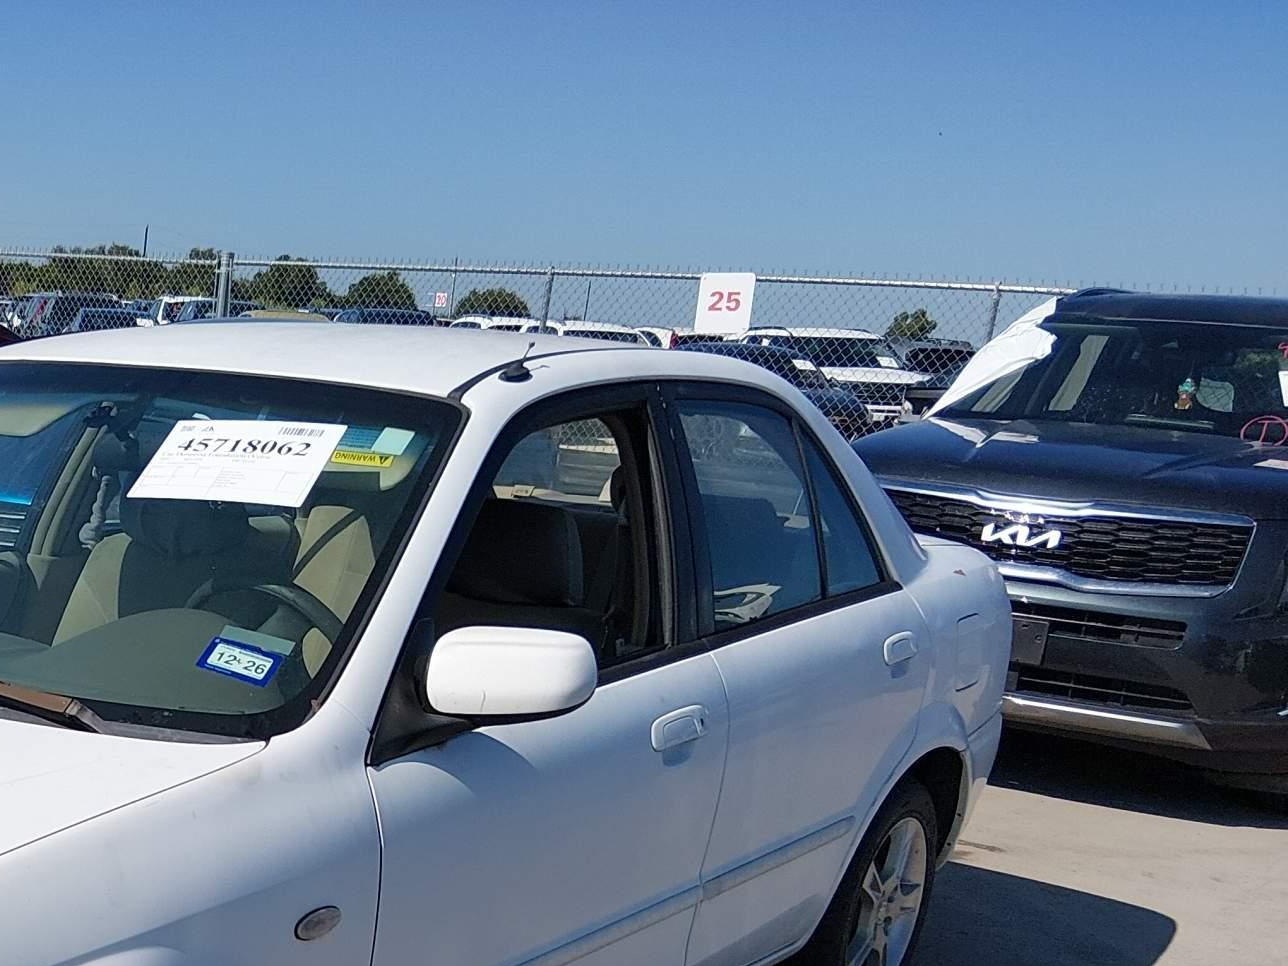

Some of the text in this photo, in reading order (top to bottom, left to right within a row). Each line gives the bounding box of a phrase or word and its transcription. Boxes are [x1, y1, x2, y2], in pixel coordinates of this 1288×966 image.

[707, 291, 741, 312] 25
[177, 438, 312, 456] 45718062
[334, 452, 376, 462] WARNING
[981, 523, 1061, 549] KIA
[216, 651, 237, 666] 12
[243, 660, 267, 675] 26
